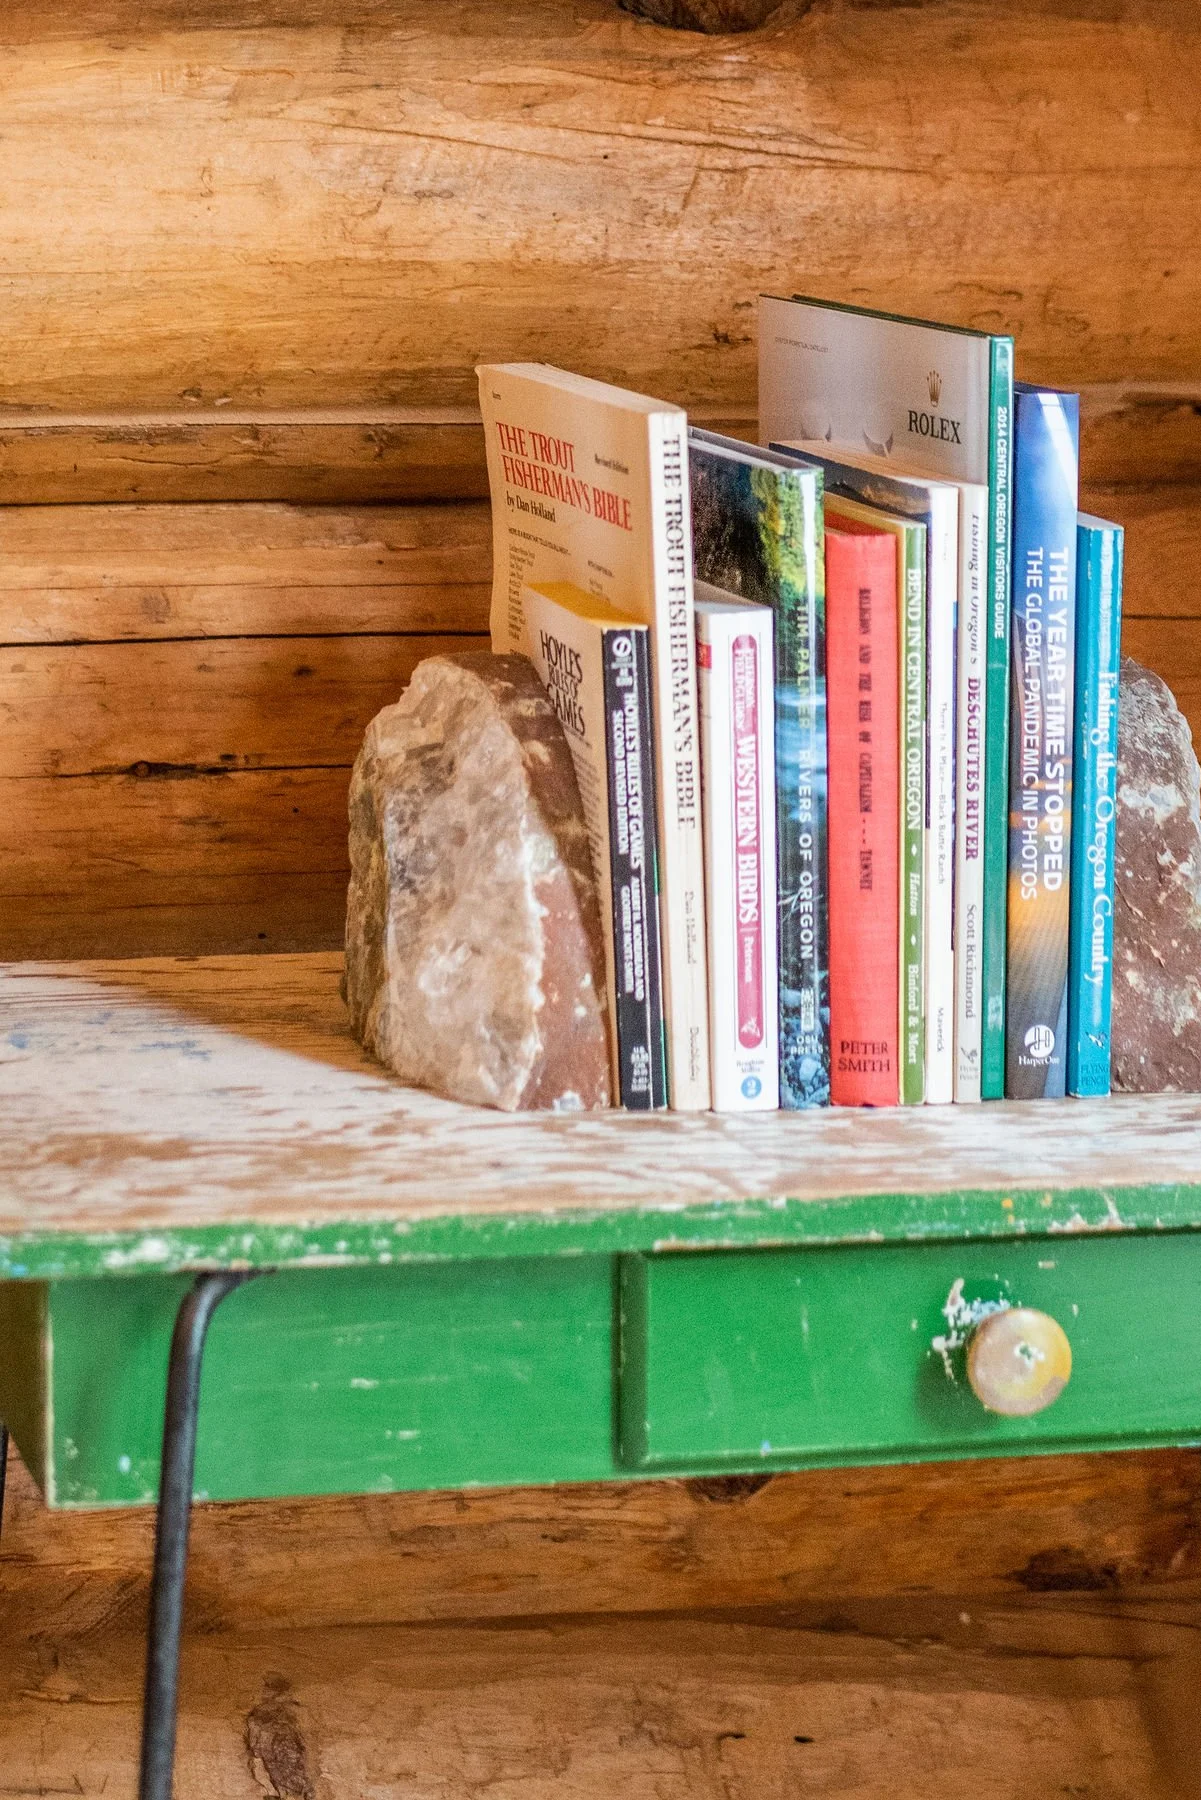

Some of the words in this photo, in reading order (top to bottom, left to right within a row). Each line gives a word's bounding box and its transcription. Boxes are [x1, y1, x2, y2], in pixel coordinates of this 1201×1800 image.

[496, 422, 528, 457] THE
[528, 431, 575, 473] TROUT
[907, 410, 962, 445] ROLEX
[663, 434, 682, 488] THE
[996, 438, 1008, 490] CENTRAL
[501, 454, 591, 514] FISHERMAN'S
[592, 487, 633, 531] BIBLE
[506, 491, 515, 512] by
[516, 495, 530, 513] Dan
[530, 501, 556, 523] Holland
[995, 492, 1007, 544] OREGON
[665, 493, 685, 579] TROUT
[994, 546, 1007, 601] VISITORS
[1026, 547, 1044, 588] THE
[1049, 547, 1069, 602] THE
[907, 568, 922, 621] BEND
[797, 604, 810, 638] TIM
[907, 623, 922, 646] IN
[994, 602, 1006, 640] GUIDE
[1024, 593, 1043, 673] GLOBAL
[1047, 607, 1068, 682] YEAR
[858, 644, 871, 664] AND
[797, 647, 811, 729] PALMER
[858, 673, 872, 692] THE
[907, 652, 922, 743] CENTRAL
[1090, 671, 1117, 746] Fishing
[546, 683, 585, 736] GAMES
[612, 710, 625, 759] SECOND
[859, 701, 872, 722] RISE
[966, 677, 981, 793] DESCHUTES
[1022, 678, 1042, 786] PANDEMIC
[1045, 686, 1066, 758] TIME
[859, 731, 872, 743] OF
[615, 759, 627, 806] REVISED
[626, 752, 643, 795] RULES
[676, 760, 696, 830] BIBLE
[736, 732, 758, 848] WESTERN
[799, 750, 812, 823] RIVERS
[859, 752, 872, 813] CAPITALISM
[906, 747, 922, 830] OREGON
[1096, 749, 1116, 791] the
[628, 796, 643, 817] OF
[1022, 788, 1038, 811] IN
[617, 806, 629, 855] EDITION
[629, 817, 646, 869] GAMES
[799, 833, 812, 861] OF
[965, 797, 980, 862] RIVER
[1043, 762, 1065, 891] STOPPED
[1087, 795, 1114, 888] Oregon
[937, 854, 947, 886] Ranch
[1021, 817, 1038, 900] PHOTOS
[738, 853, 760, 923] BIRDS
[799, 871, 814, 959] OREGON
[966, 903, 978, 941] Scott
[1084, 895, 1111, 987] Country
[965, 944, 977, 1019] Richmond
[840, 1040, 889, 1055] PETER
[908, 1016, 919, 1028] &
[936, 1006, 945, 1052] Maverick
[838, 1057, 891, 1073] SMITH
[1018, 1054, 1060, 1068] HarperOne
